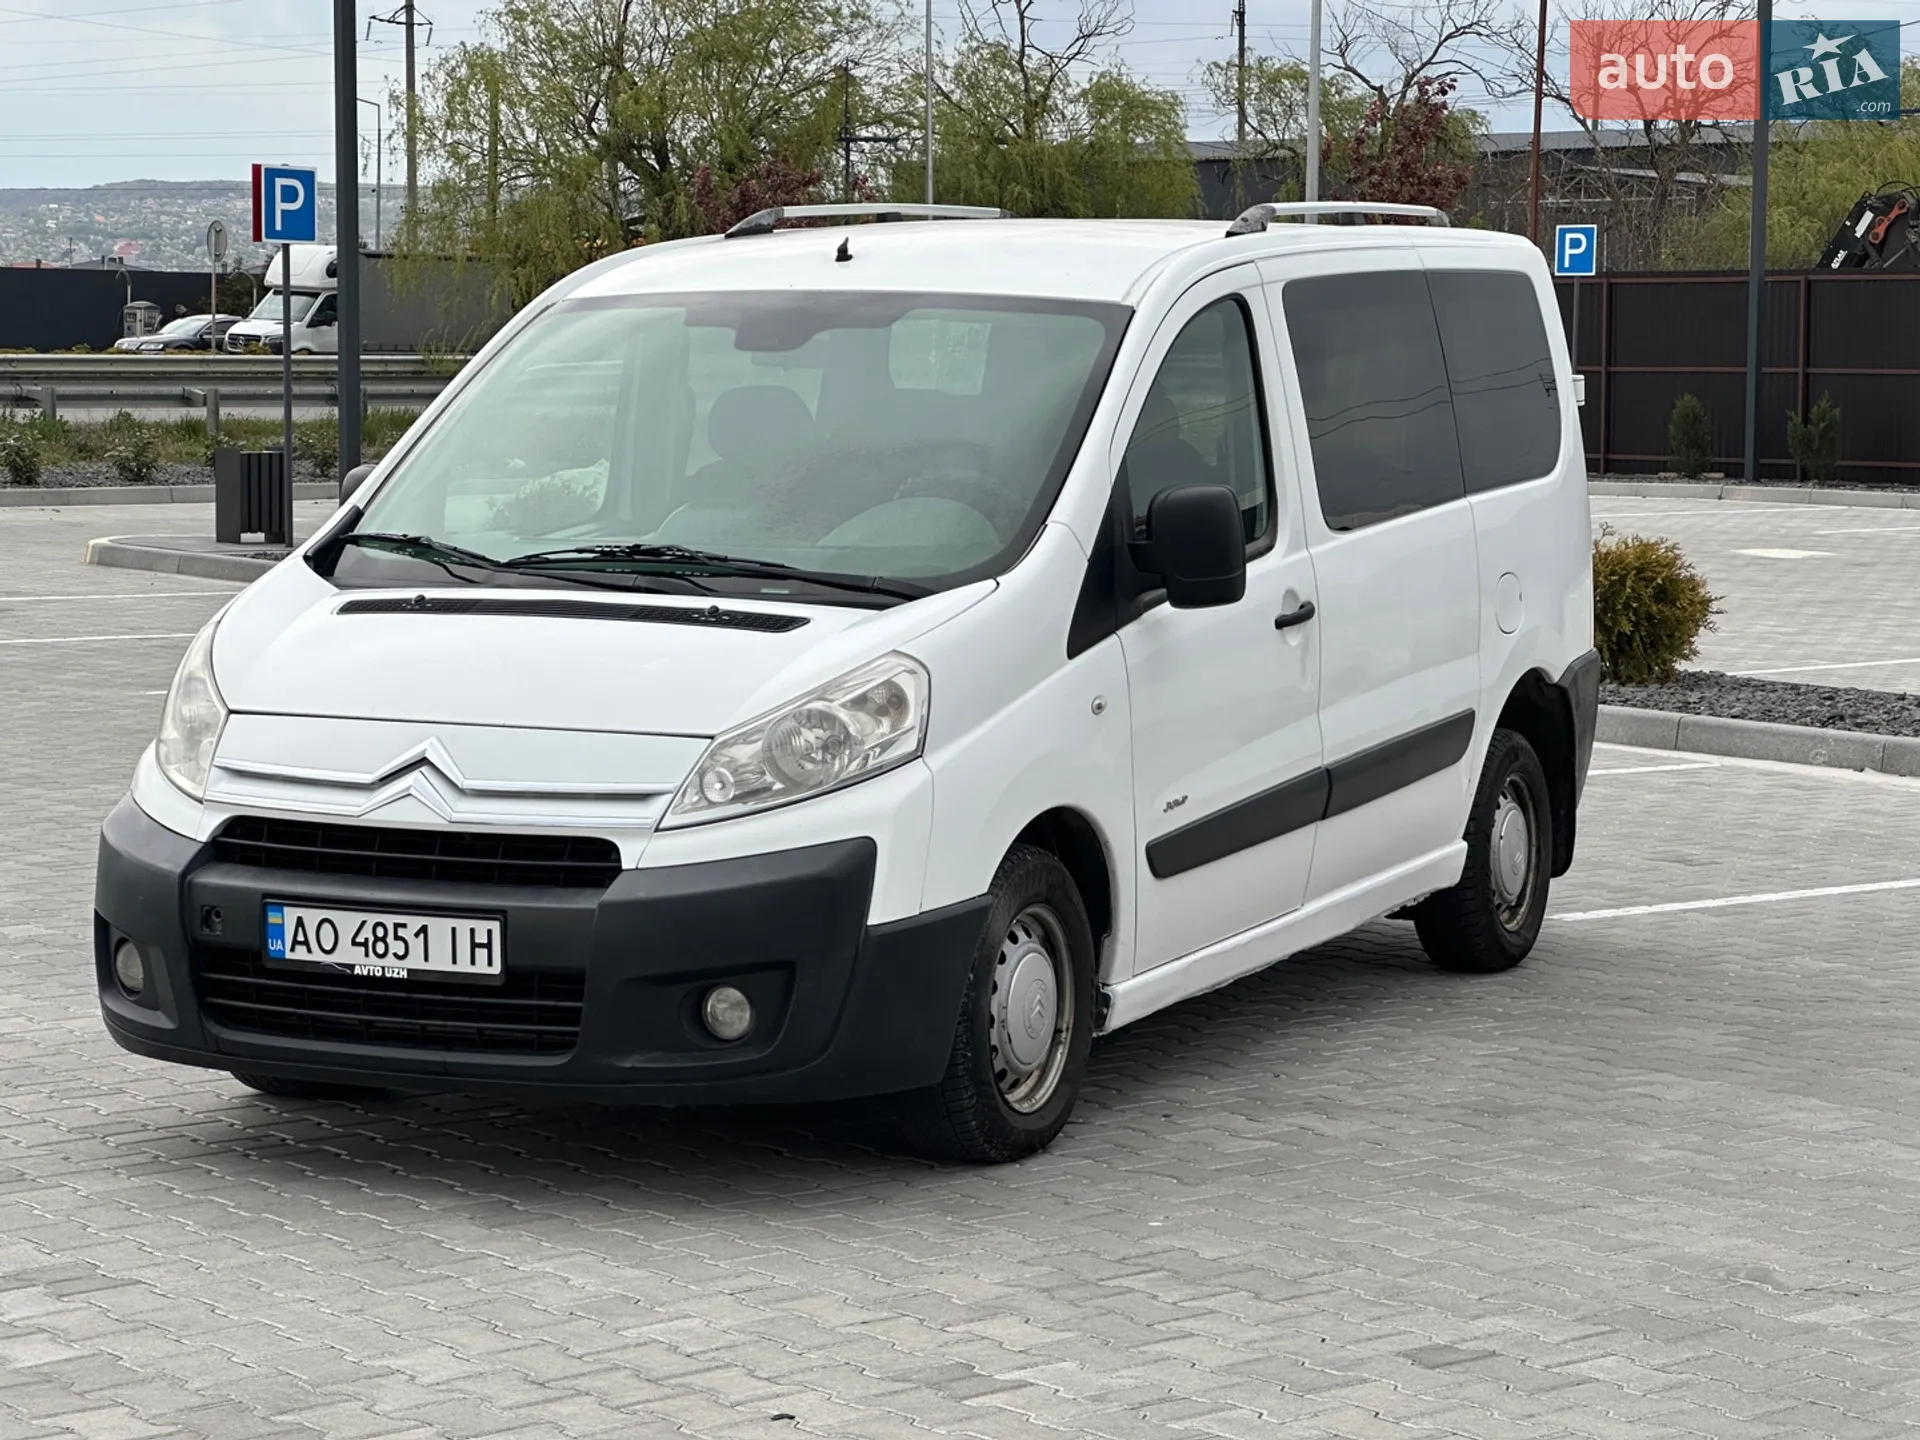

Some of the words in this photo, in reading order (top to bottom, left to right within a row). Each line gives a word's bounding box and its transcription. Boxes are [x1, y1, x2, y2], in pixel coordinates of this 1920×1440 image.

[274, 177, 305, 231] P
[1564, 233, 1587, 268] P
[268, 938, 284, 951] UA
[289, 915, 339, 956] AO
[350, 920, 430, 963] 4851
[450, 926, 493, 967] IH
[353, 965, 383, 977] AVTO
[385, 967, 408, 979] UZH
